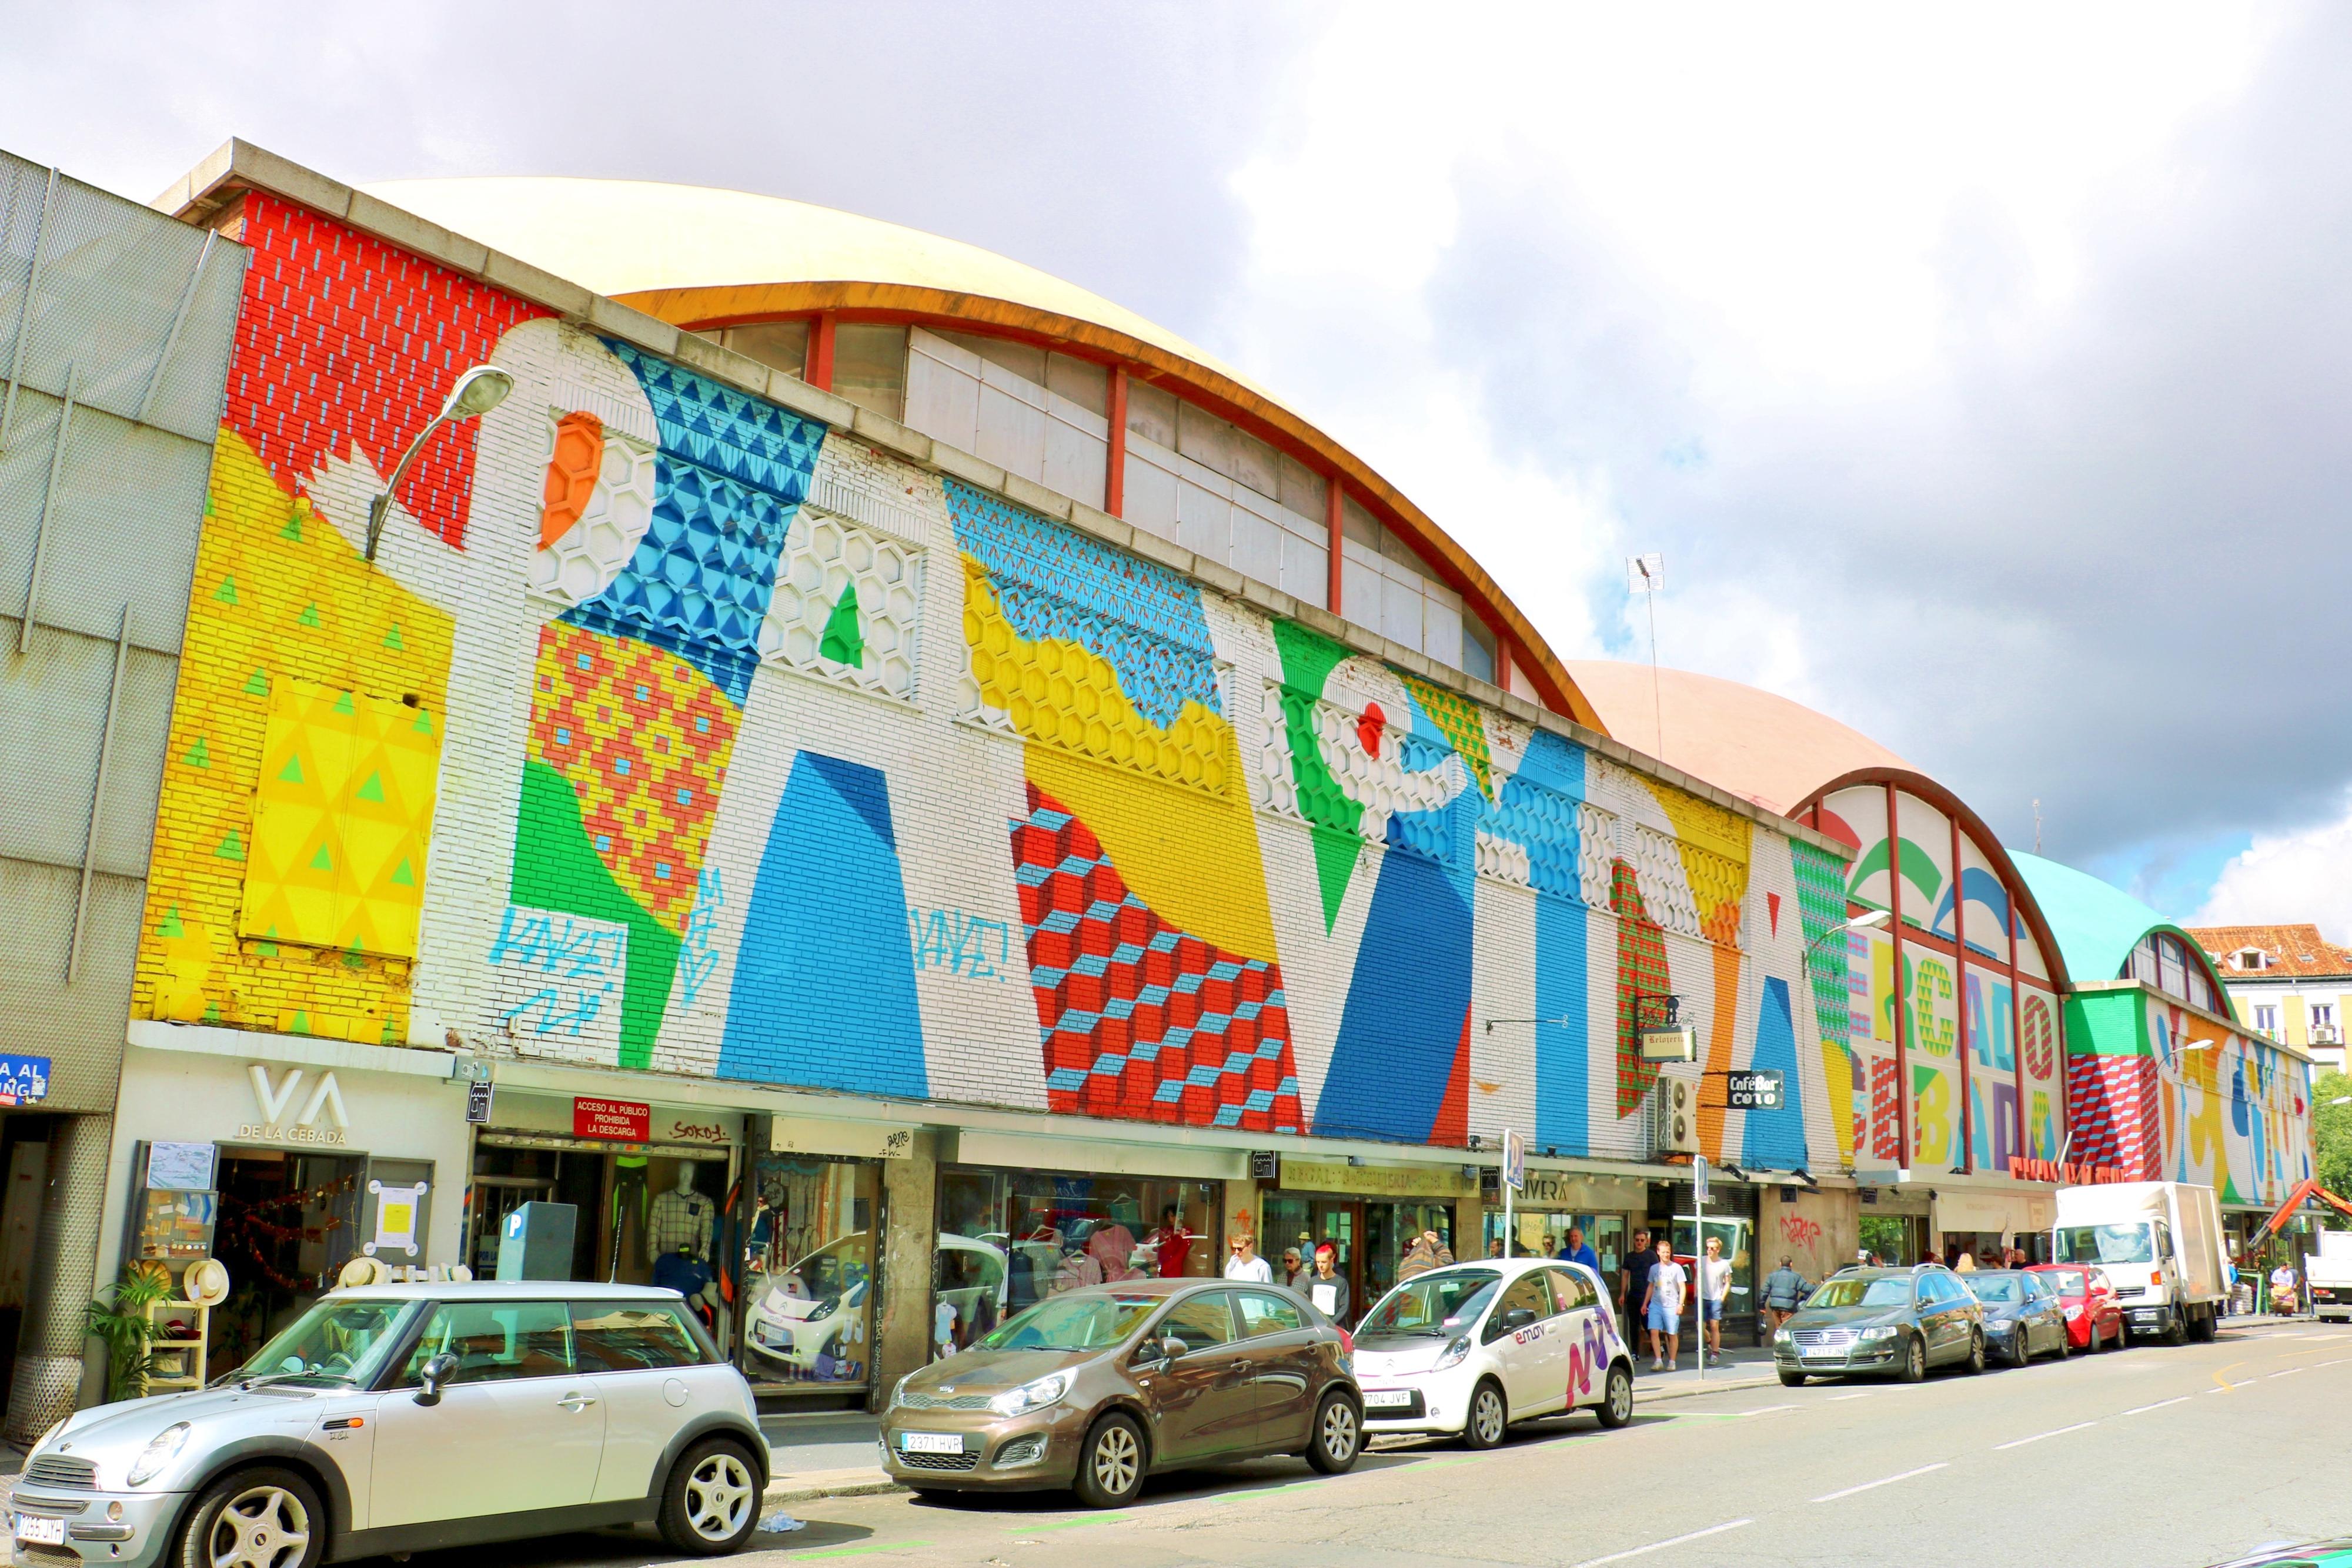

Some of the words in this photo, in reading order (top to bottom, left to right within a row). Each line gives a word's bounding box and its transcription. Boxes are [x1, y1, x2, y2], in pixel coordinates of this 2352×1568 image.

[1847, 930, 2053, 1081] ERCADO
[18, 1064, 42, 1078] AL
[248, 1065, 349, 1128] VA
[577, 1101, 606, 1112] ACCESO
[608, 1104, 617, 1114] AL
[619, 1104, 647, 1116] PÚBLICO
[594, 1114, 630, 1125] PROHIBIDA
[240, 1124, 260, 1138] DE
[265, 1126, 283, 1140] LA
[288, 1128, 346, 1145] CEBADA
[587, 1124, 597, 1133] LA
[599, 1125, 636, 1136] DESCARGA
[1515, 1324, 1545, 1345] emov
[1390, 1393, 1407, 1403] JVF
[910, 1436, 935, 1449] 2371
[940, 1437, 960, 1451] HVR
